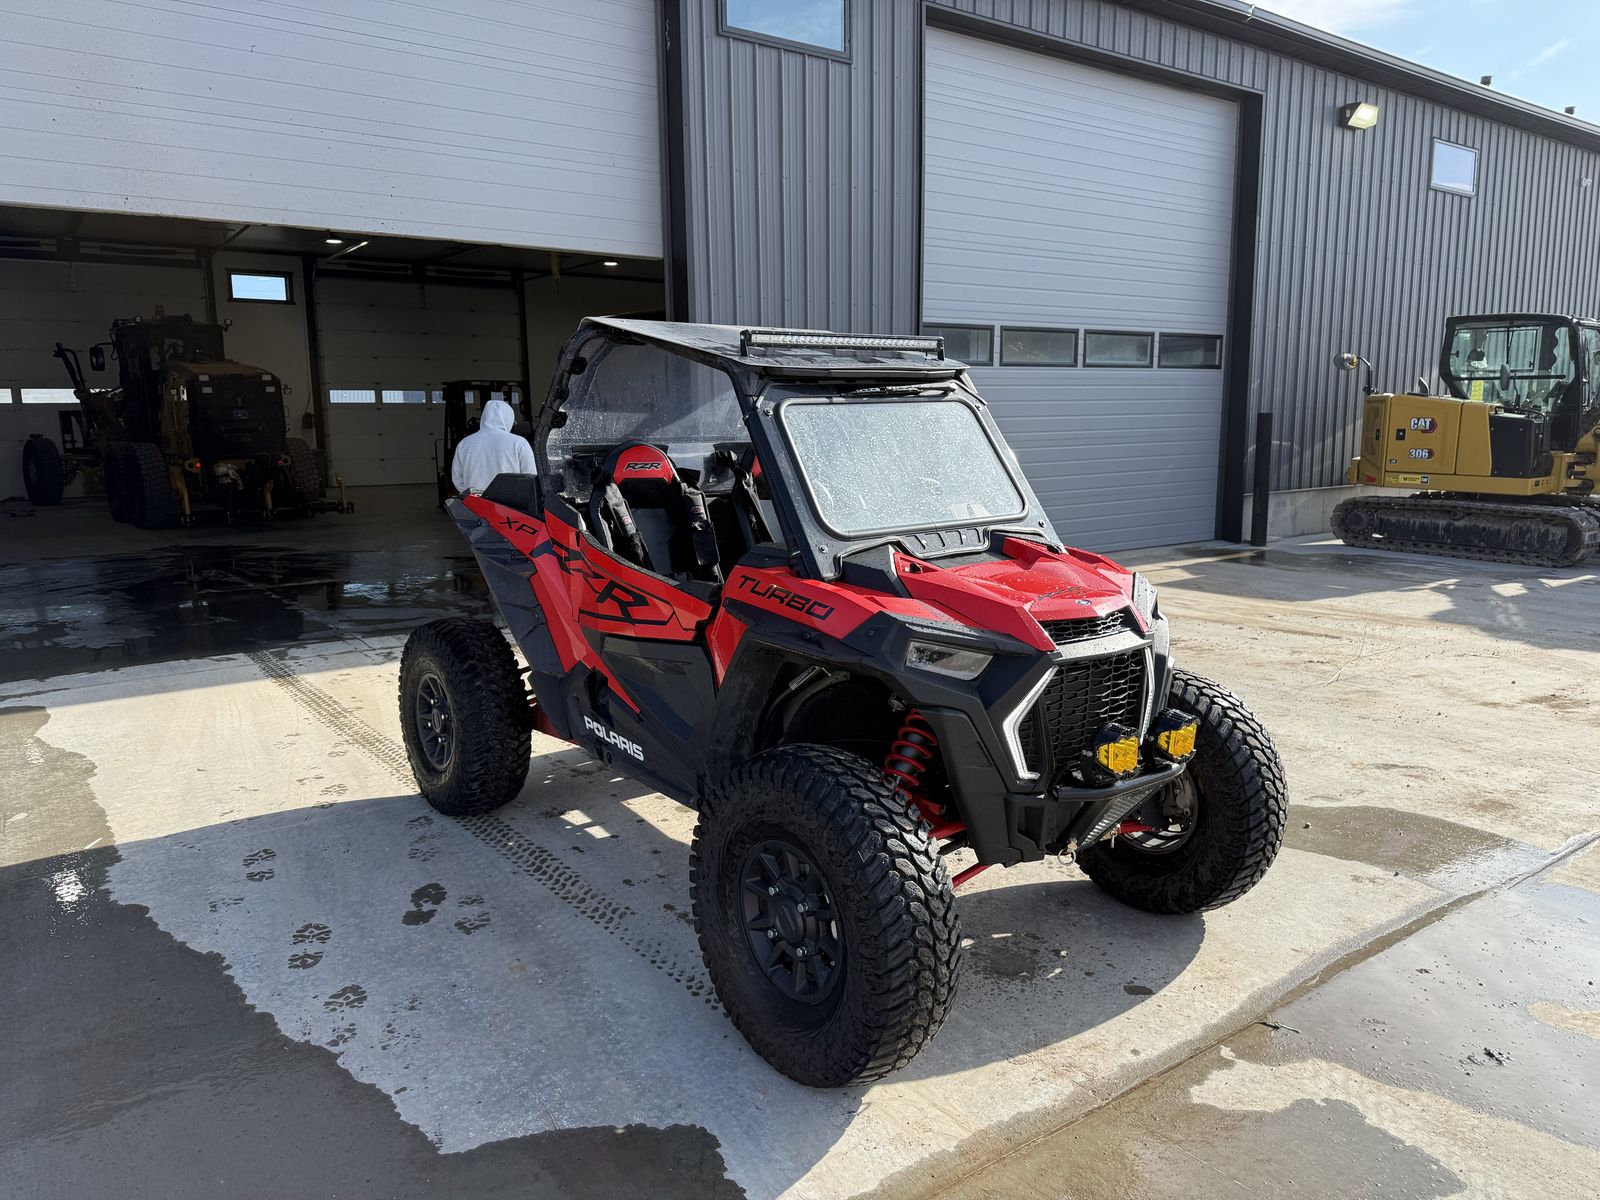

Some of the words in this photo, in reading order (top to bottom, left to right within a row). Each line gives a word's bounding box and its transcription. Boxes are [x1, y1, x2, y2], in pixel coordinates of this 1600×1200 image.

[1410, 418, 1432, 431] CAT
[1409, 448, 1429, 460] 306
[624, 461, 662, 472] RZR
[499, 515, 538, 536] XP
[739, 575, 835, 620] TURBO
[584, 715, 644, 762] POLARIS
